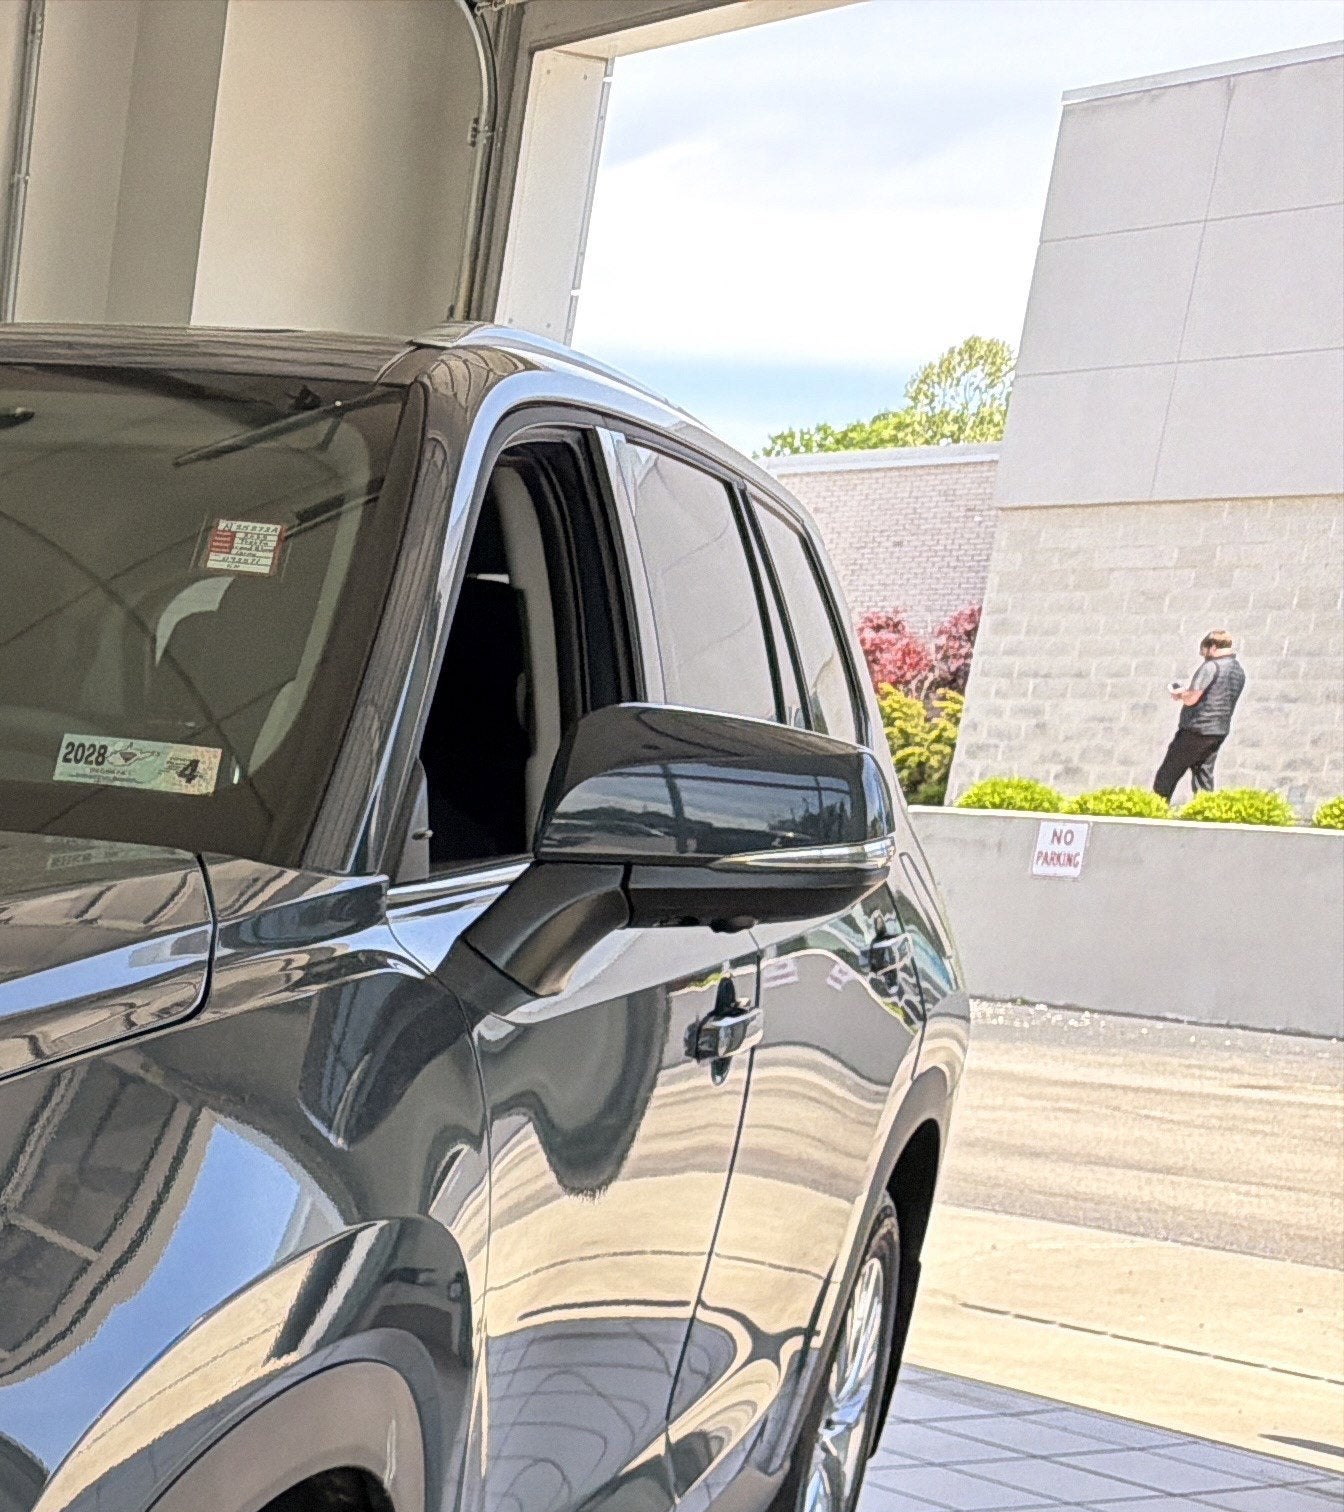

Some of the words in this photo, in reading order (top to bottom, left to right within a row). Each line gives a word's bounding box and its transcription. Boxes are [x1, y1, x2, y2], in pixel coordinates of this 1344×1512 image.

[62, 741, 108, 767] 2028
[176, 758, 200, 784] 4
[1051, 828, 1075, 846] NO
[1036, 850, 1080, 868] PARKING
